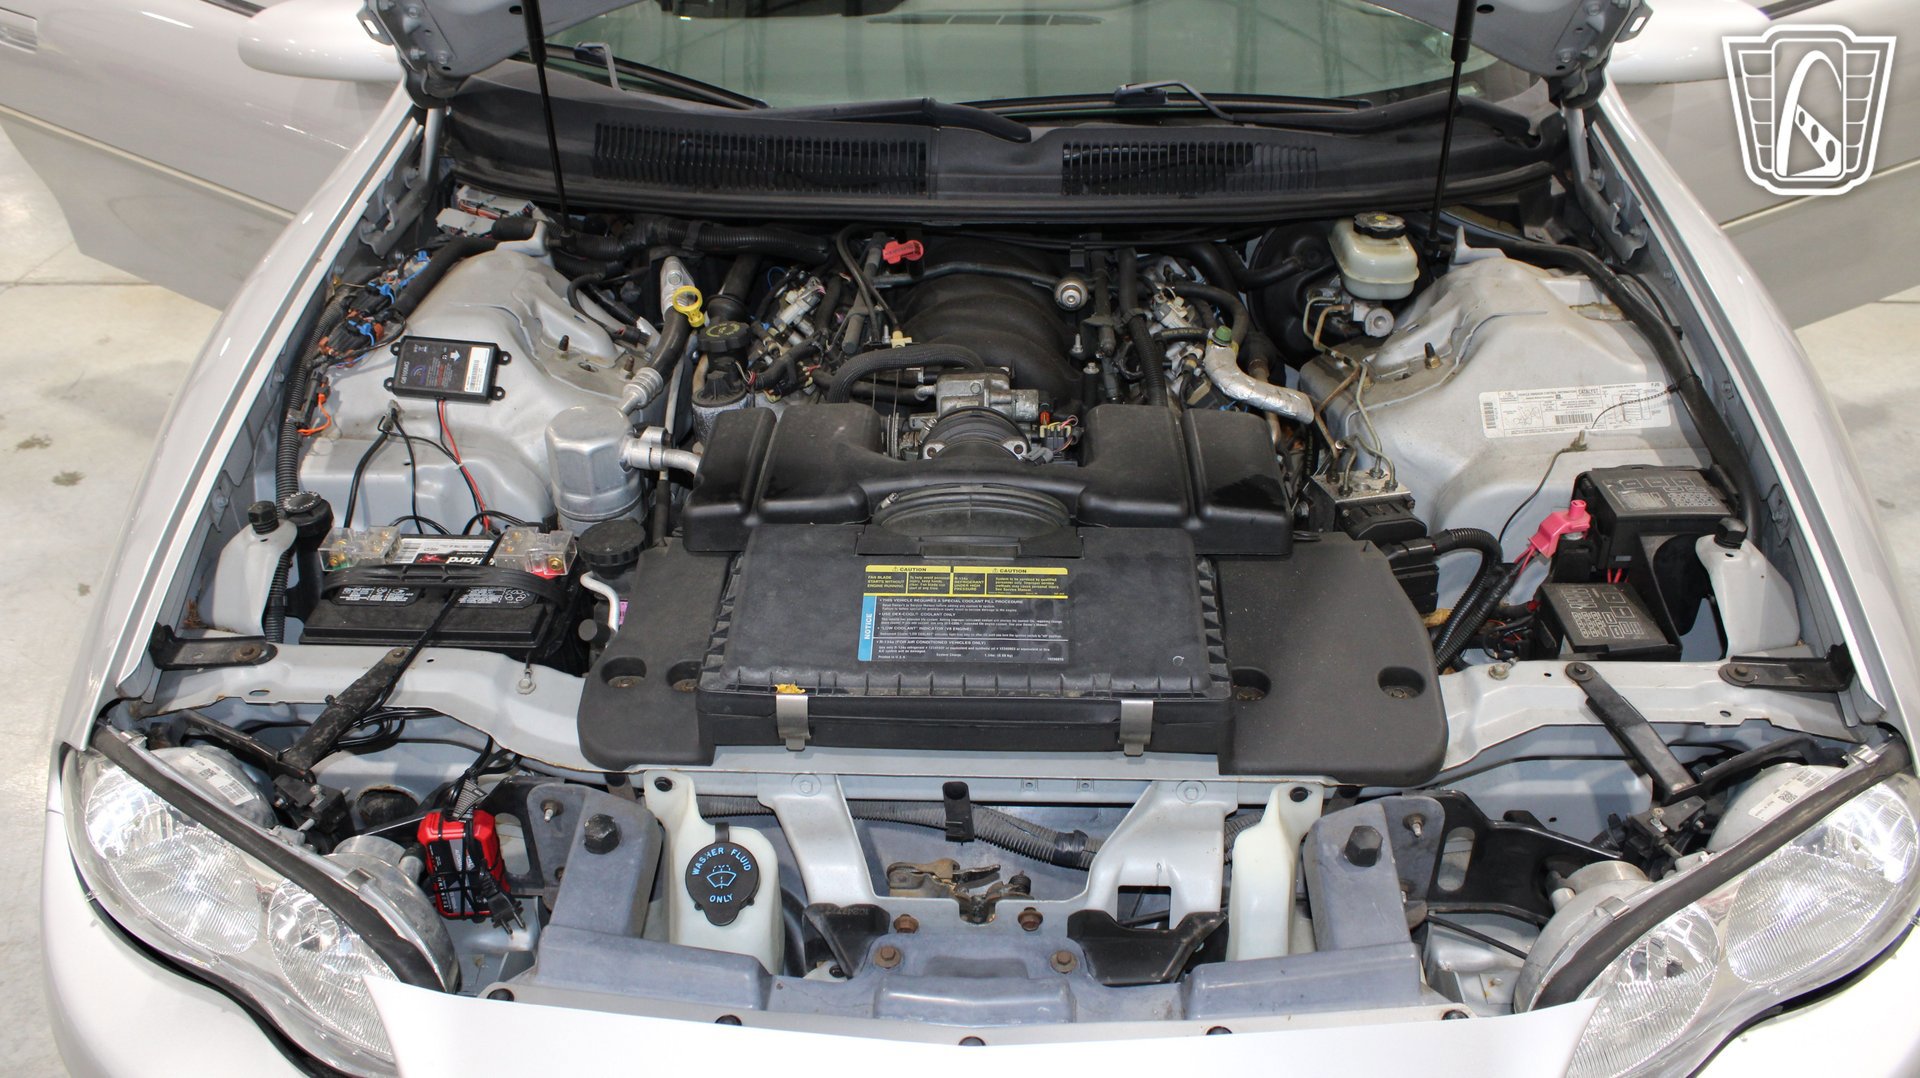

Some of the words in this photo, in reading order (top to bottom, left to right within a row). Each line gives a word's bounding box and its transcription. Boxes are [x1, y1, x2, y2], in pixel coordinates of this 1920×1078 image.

[864, 613, 873, 640] NOTICE
[692, 847, 724, 875] WASHER
[730, 848, 752, 871] FLUID
[709, 893, 734, 903] ONLY
